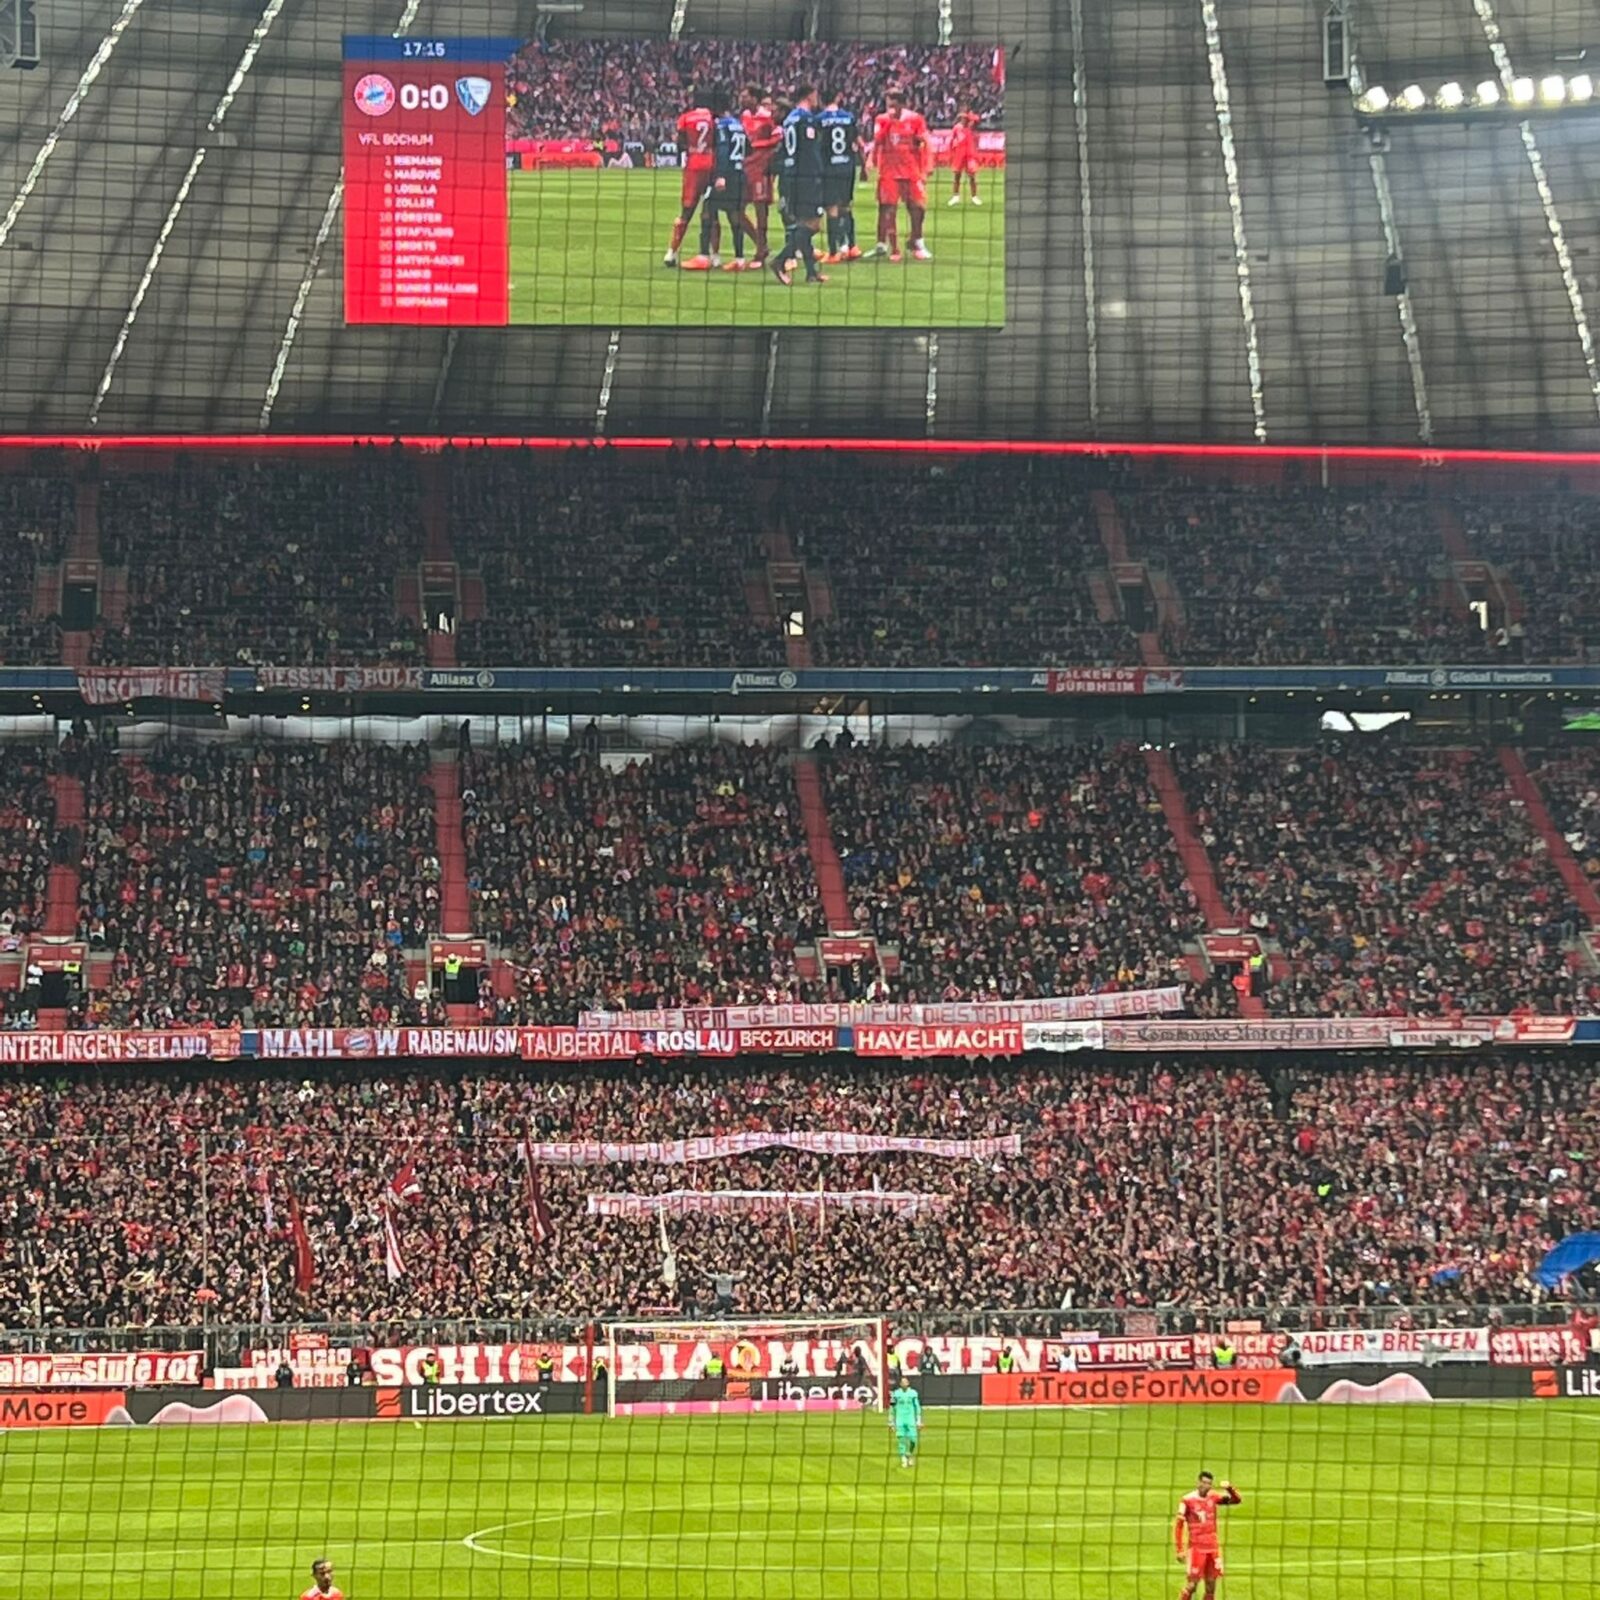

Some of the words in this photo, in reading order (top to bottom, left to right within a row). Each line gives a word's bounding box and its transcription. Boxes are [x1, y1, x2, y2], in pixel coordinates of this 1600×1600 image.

[403, 42, 446, 56] 17:15
[400, 83, 449, 110] 0:0
[383, 133, 434, 146] BOCHUM
[831, 127, 846, 154] 8
[430, 672, 475, 685] Allianz
[731, 673, 778, 687] Allianz
[1385, 671, 1429, 683] Allianz
[1450, 671, 1491, 683] Global
[1493, 671, 1553, 683] Investors
[125, 1036, 208, 1059] SEELAND
[525, 1030, 637, 1057] TAUBERTAL
[656, 1030, 734, 1052] ROSLAU
[858, 1029, 1019, 1050] HAVELMACHT
[1098, 1339, 1191, 1363] FANATIC
[1302, 1334, 1365, 1352] ADLER
[155, 1353, 200, 1383] rot
[1018, 1373, 1262, 1402] #TradeForMore
[2, 1397, 88, 1422] More
[410, 1388, 542, 1416] Libertex
